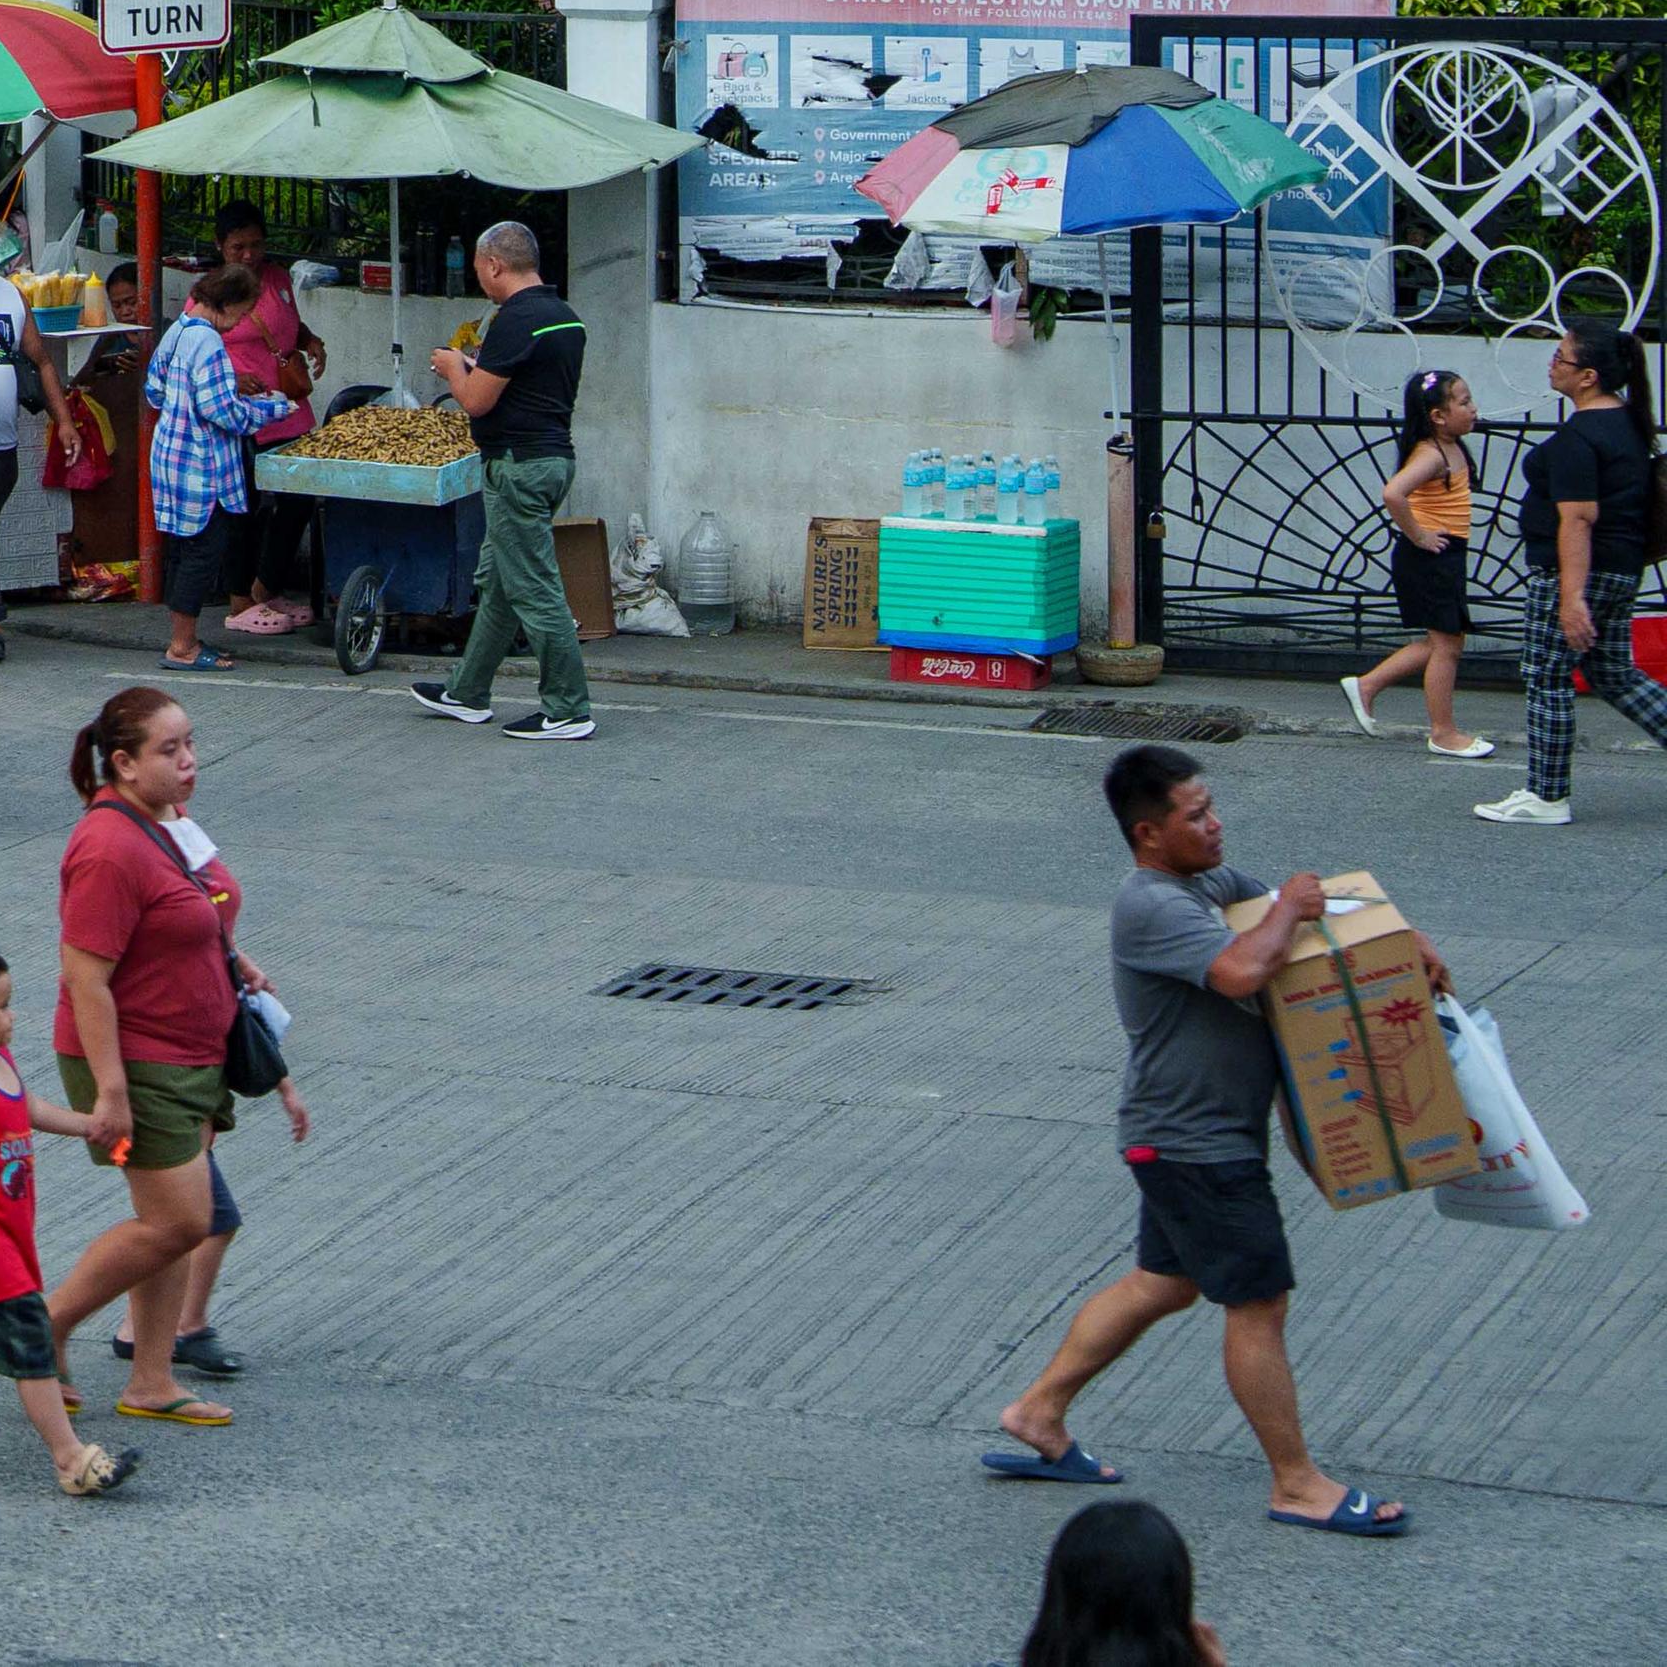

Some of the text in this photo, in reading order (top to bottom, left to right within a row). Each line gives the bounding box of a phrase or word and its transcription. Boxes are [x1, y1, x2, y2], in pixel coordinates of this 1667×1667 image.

[933, 8, 948, 17] OF
[956, 7, 982, 19] THE
[987, 7, 1068, 20] FOLLOWING
[128, 5, 204, 37] TURN
[723, 83, 751, 93] Bags
[713, 93, 773, 104] Backpacks
[904, 93, 948, 104] Jackets
[829, 129, 910, 141] Government
[829, 150, 867, 163] Major
[709, 172, 777, 187] AREAS:
[812, 535, 828, 633] NATURE'S
[827, 548, 844, 626] SPRING
[990, 661, 1002, 677] 8
